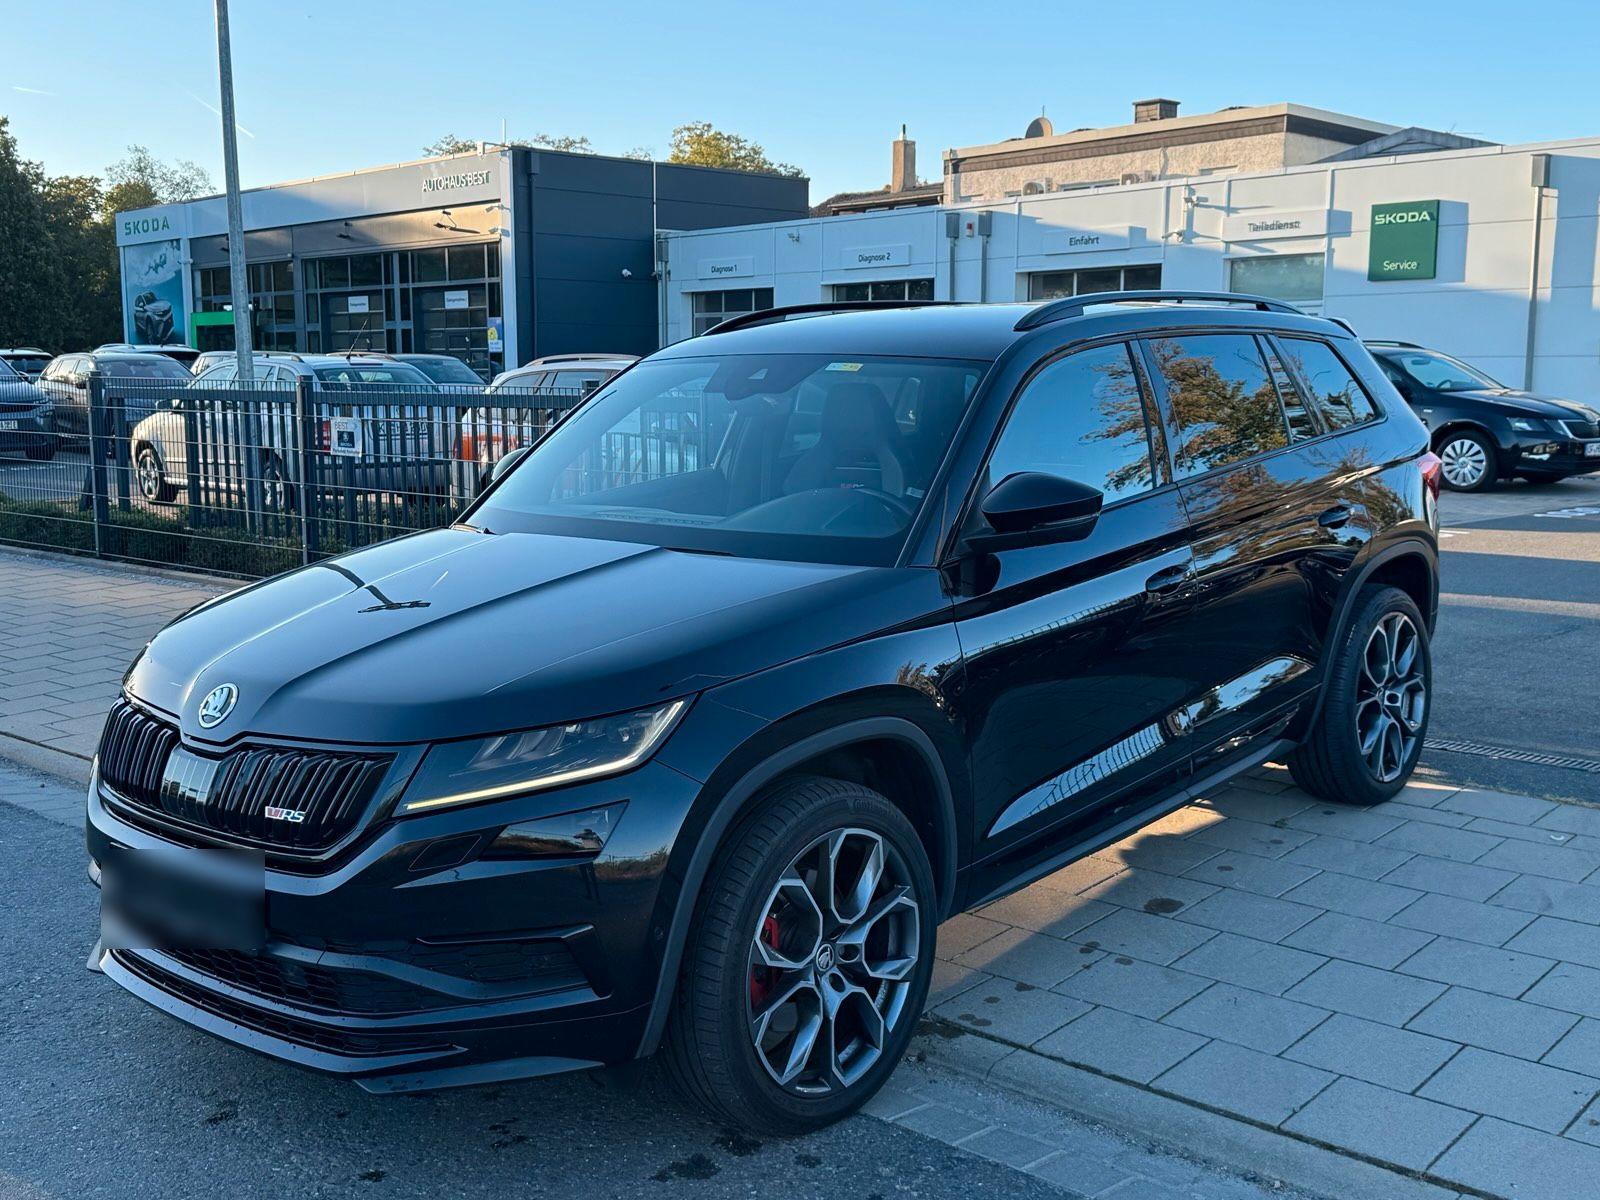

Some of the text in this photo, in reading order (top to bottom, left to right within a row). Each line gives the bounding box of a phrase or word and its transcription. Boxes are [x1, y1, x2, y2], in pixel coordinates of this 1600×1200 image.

[467, 170, 490, 186] BEST
[1374, 210, 1431, 225] SKODA
[124, 216, 170, 236] SKODA
[1069, 235, 1099, 247] Einfahrt
[858, 252, 891, 264] Diagnose 2
[711, 265, 734, 274] Diagnose
[1383, 260, 1417, 271] Service
